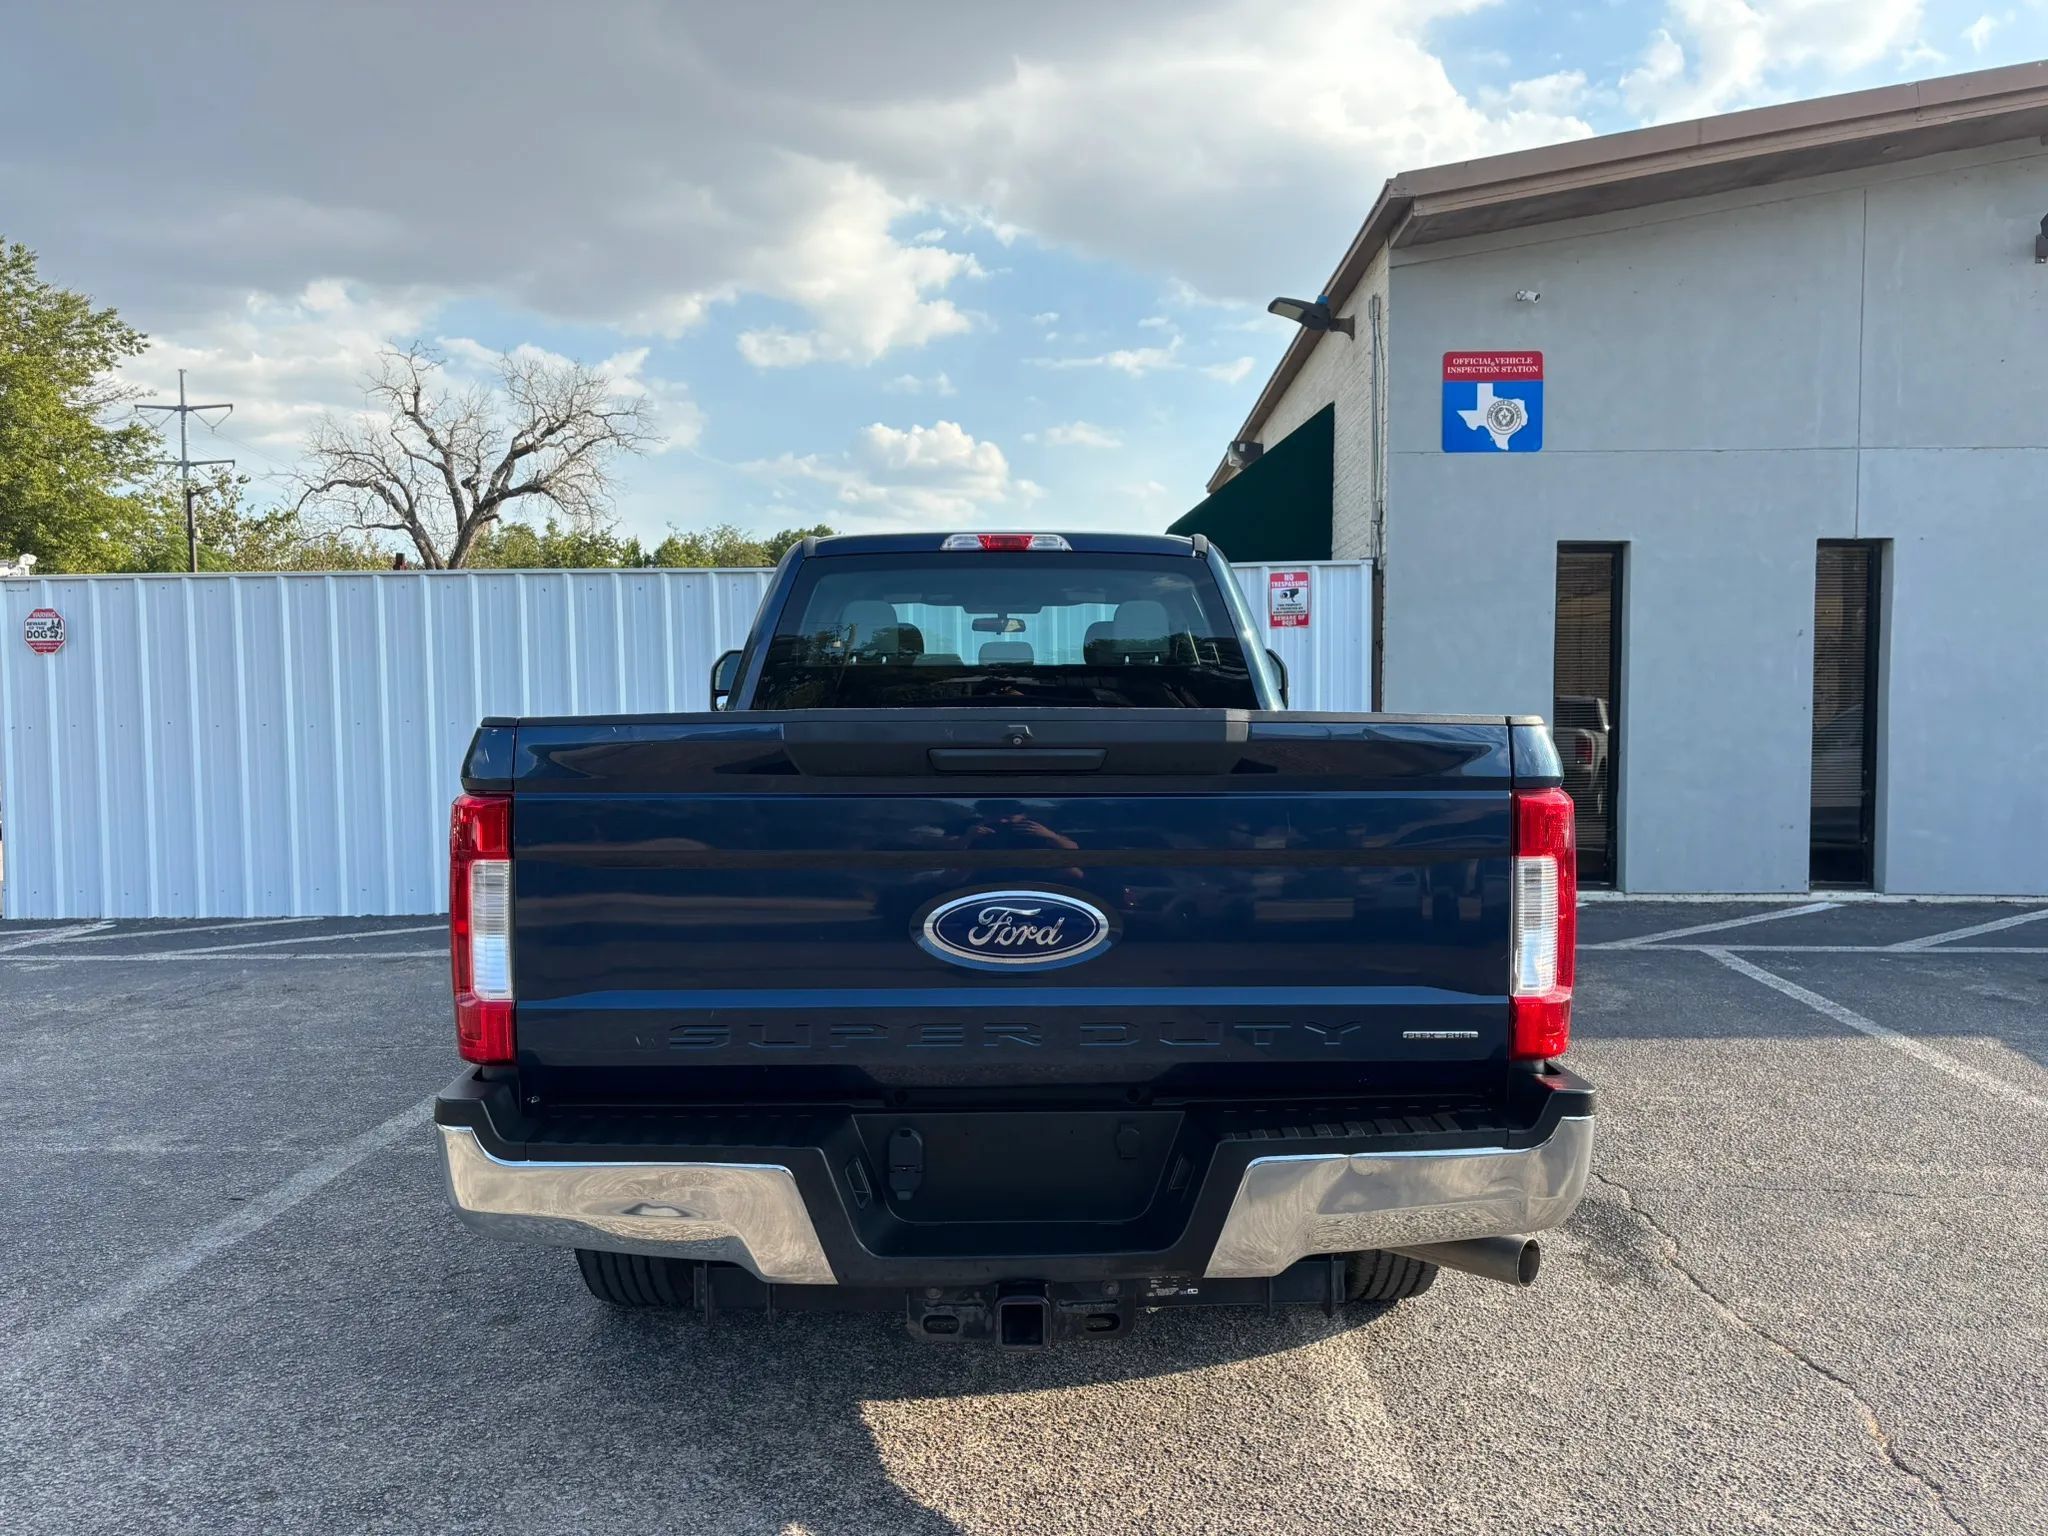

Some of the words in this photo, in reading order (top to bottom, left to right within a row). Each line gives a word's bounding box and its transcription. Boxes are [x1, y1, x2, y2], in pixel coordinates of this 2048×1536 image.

[1453, 357, 1492, 365] OFFICIAL
[1447, 365, 1500, 374] INSPECTION
[1501, 365, 1539, 373] STATION
[26, 630, 48, 639] DOG
[968, 906, 1065, 946] Ford
[669, 1022, 1042, 1050] SUPER
[1080, 1020, 1362, 1047] DUTY
